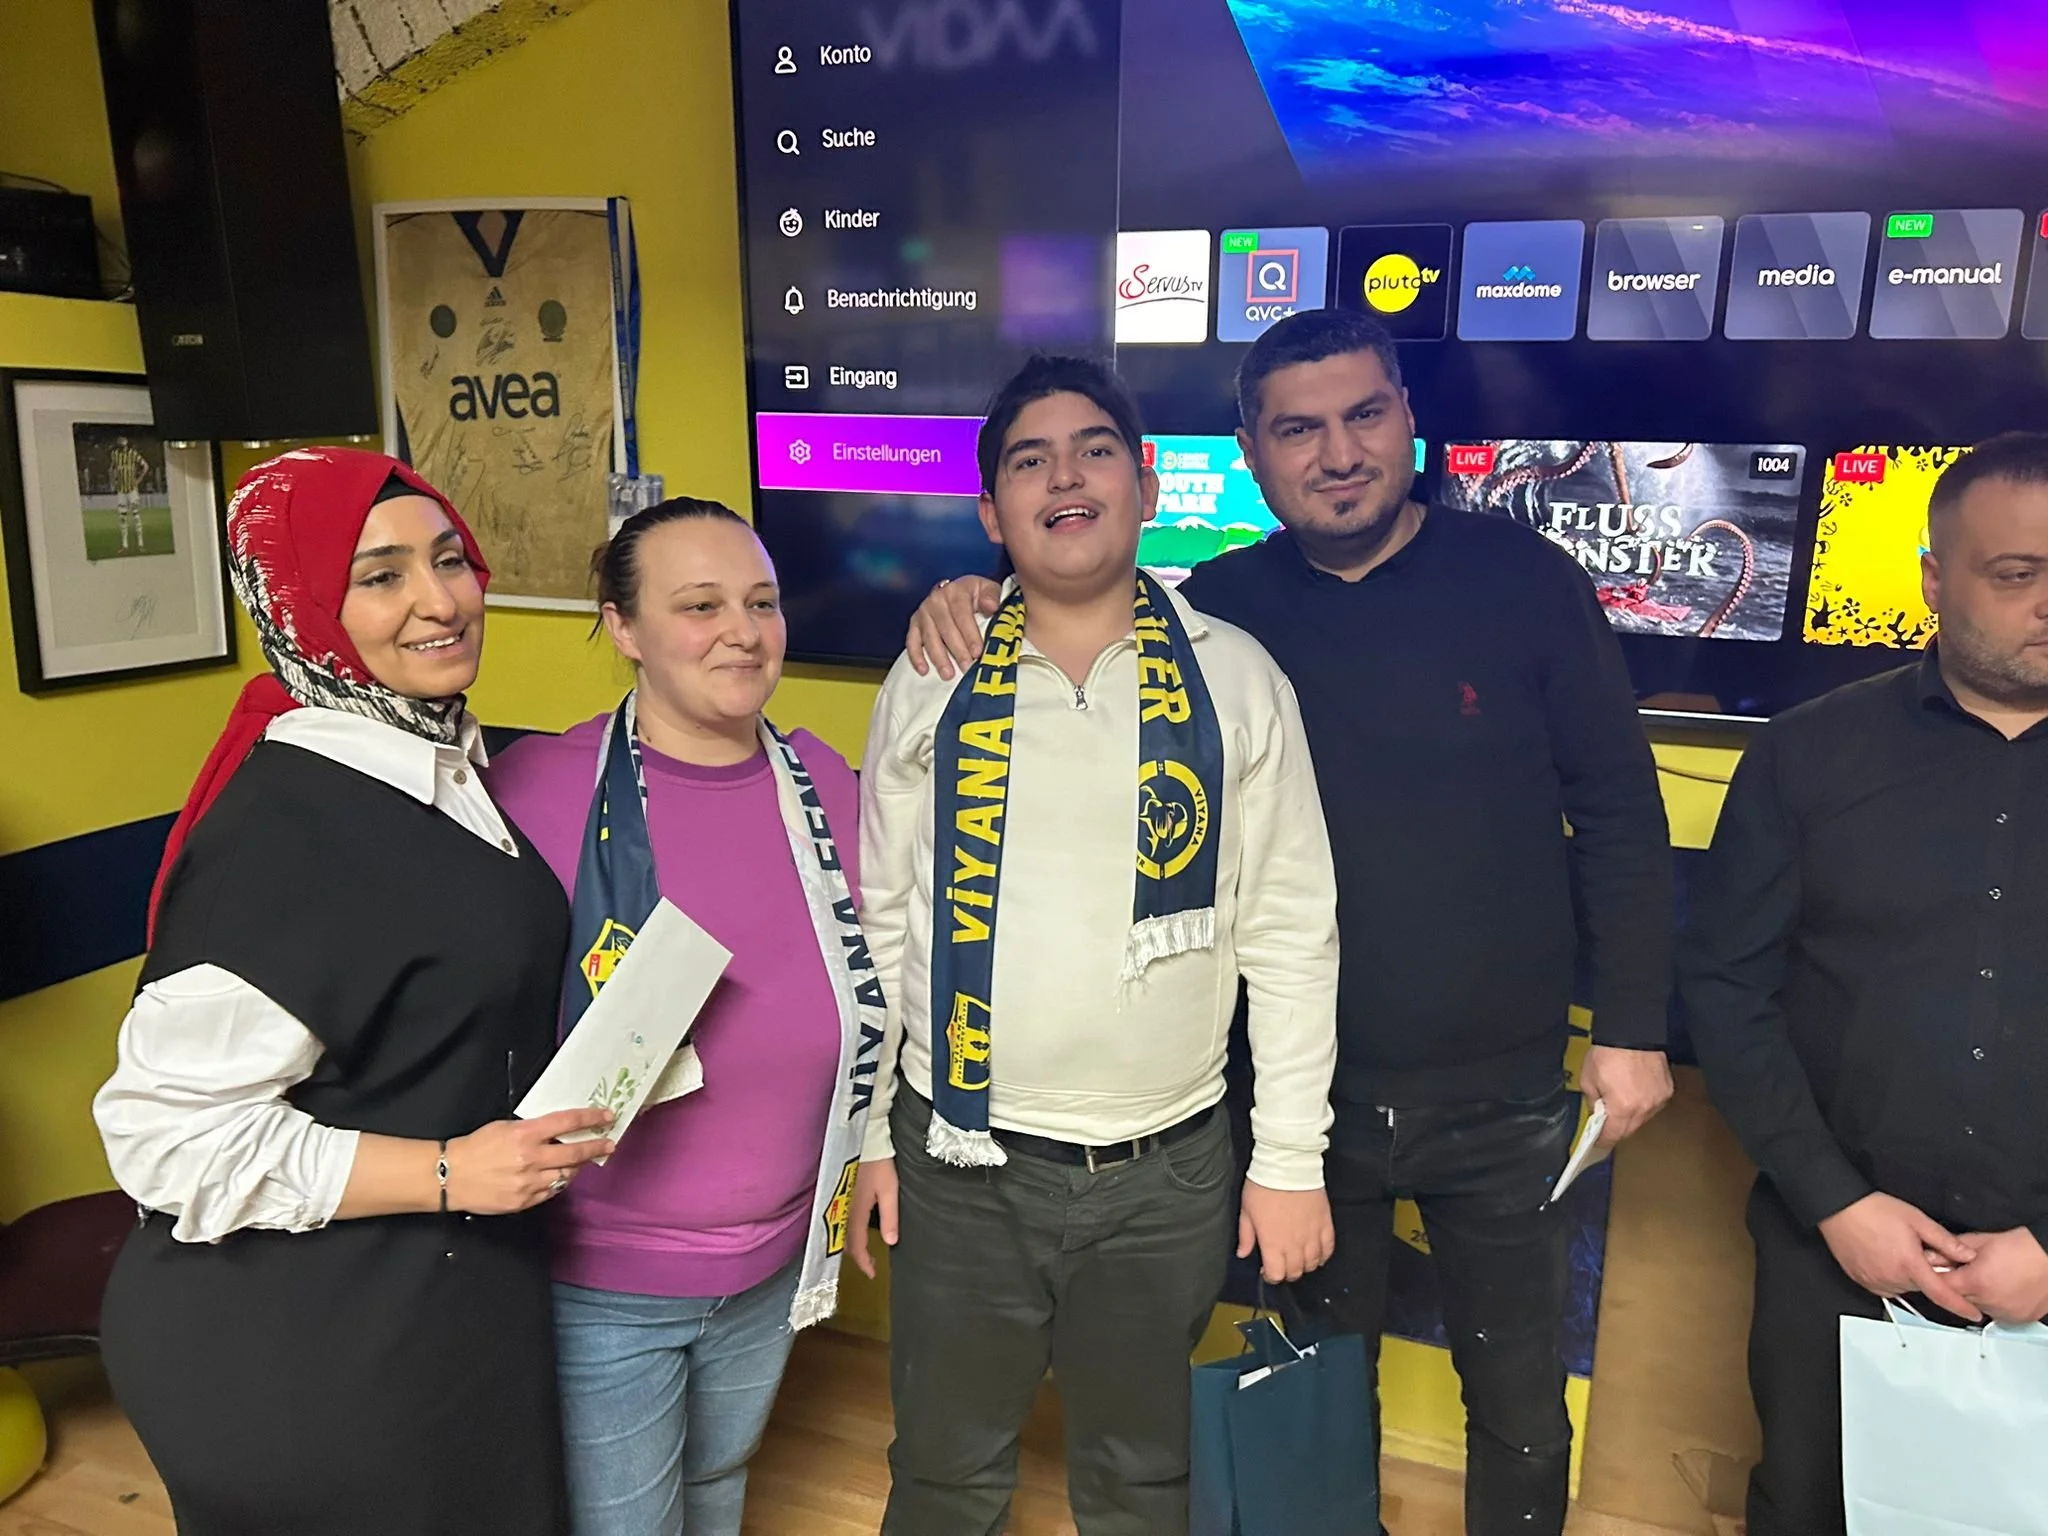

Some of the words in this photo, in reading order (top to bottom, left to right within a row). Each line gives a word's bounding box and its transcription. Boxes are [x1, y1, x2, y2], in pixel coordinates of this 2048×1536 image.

[820, 45, 872, 66] Konto
[822, 127, 876, 149] Suche
[825, 209, 880, 230] Kinder
[1895, 219, 1926, 232] NEW
[1228, 236, 1253, 249] NEW
[1258, 261, 1287, 291] Q
[1607, 270, 1701, 292] browser
[1757, 264, 1836, 287] media
[1888, 263, 2002, 286] e-manual
[827, 287, 977, 312] Benachrichtigung
[1476, 281, 1562, 299] maxdome
[830, 366, 898, 389] Eingang
[449, 370, 561, 422] avea
[833, 442, 941, 467] Einstellungen
[1456, 452, 1488, 467] LIVE
[1757, 456, 1791, 473] 1004
[1842, 458, 1879, 474] LIVE
[1159, 471, 1225, 494] OUTH
[1550, 502, 1683, 538] FLUSS
[1560, 536, 1719, 577] NSTER
